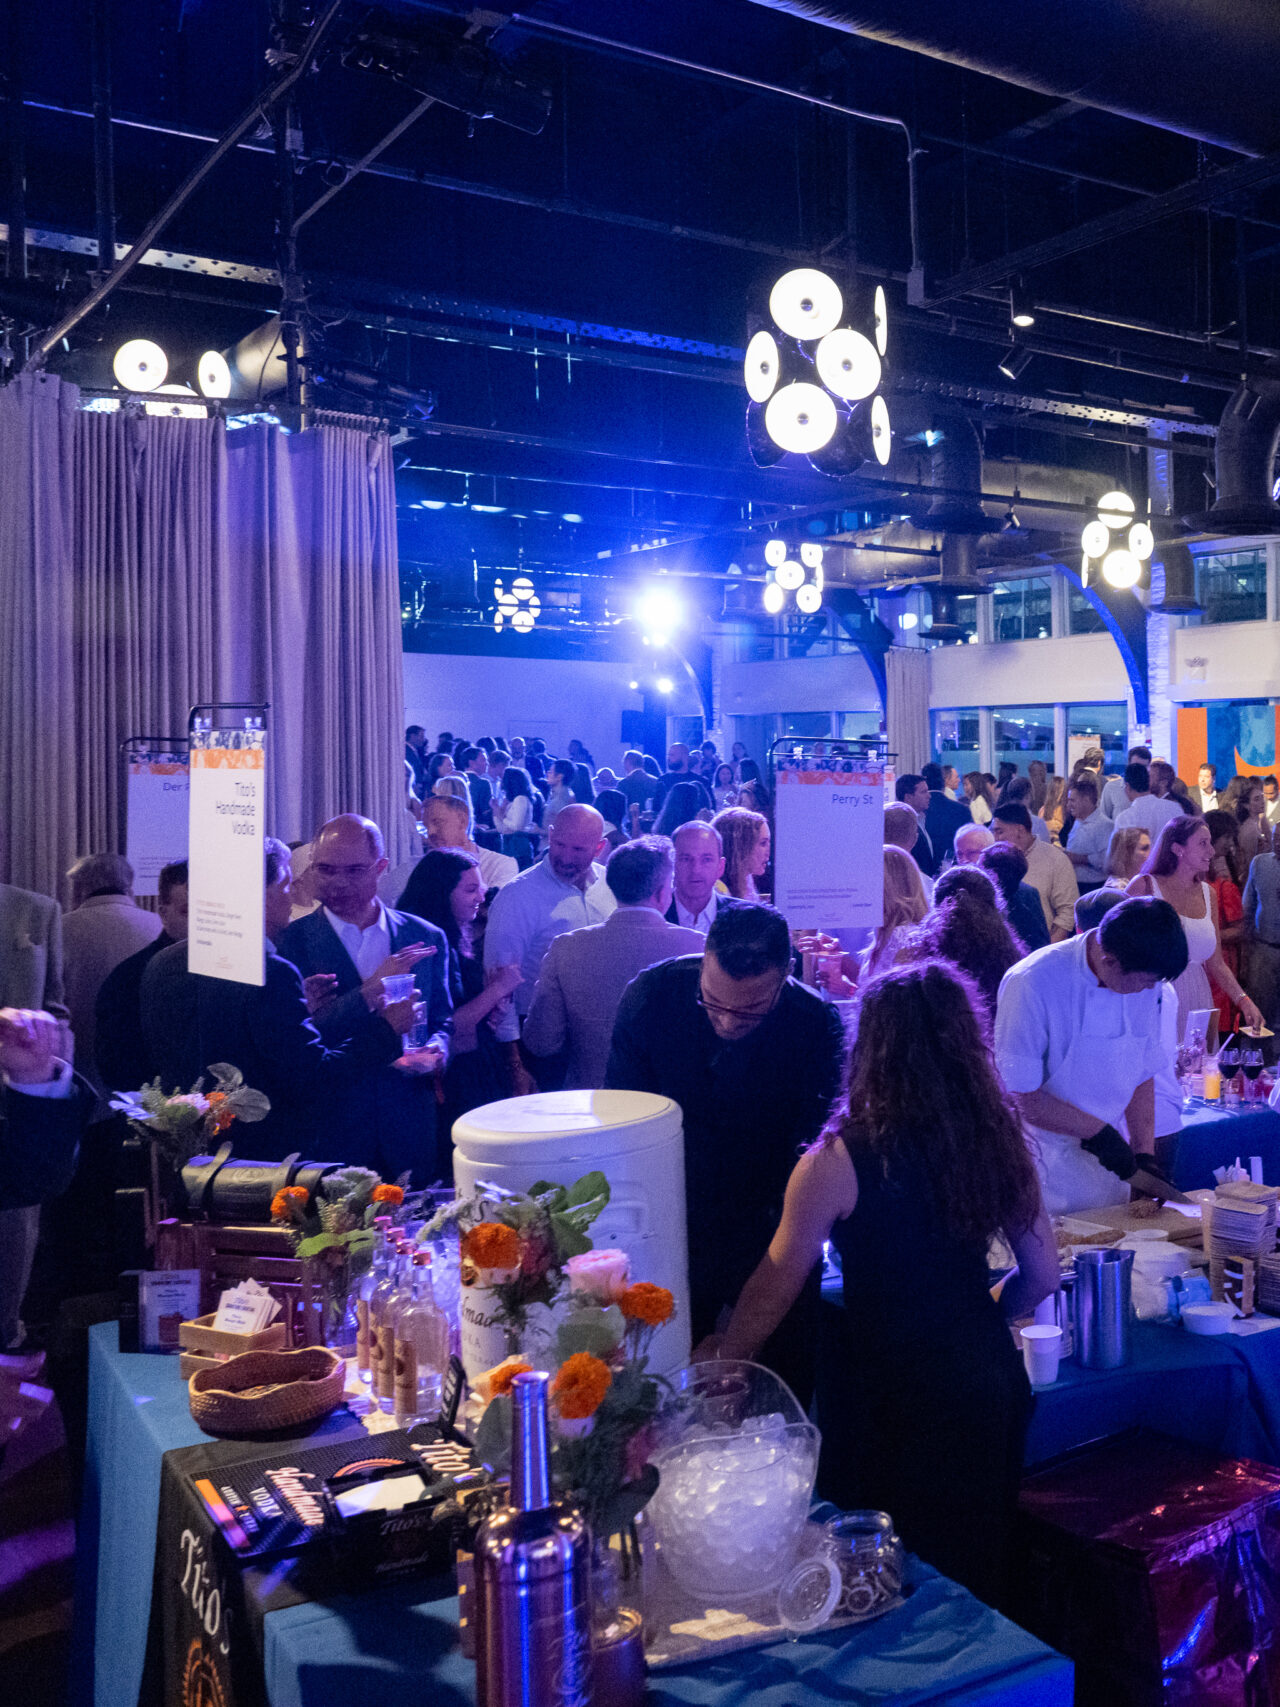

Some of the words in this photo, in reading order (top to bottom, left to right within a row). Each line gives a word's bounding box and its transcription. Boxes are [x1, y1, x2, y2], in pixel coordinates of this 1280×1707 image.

[234, 781, 256, 797] Tito's
[215, 800, 256, 816] Handmade
[832, 794, 861, 807] Perry
[863, 794, 873, 804] St
[232, 820, 256, 836] Vodka
[248, 1486, 284, 1519] VODKA
[180, 1529, 233, 1655] Tito's
